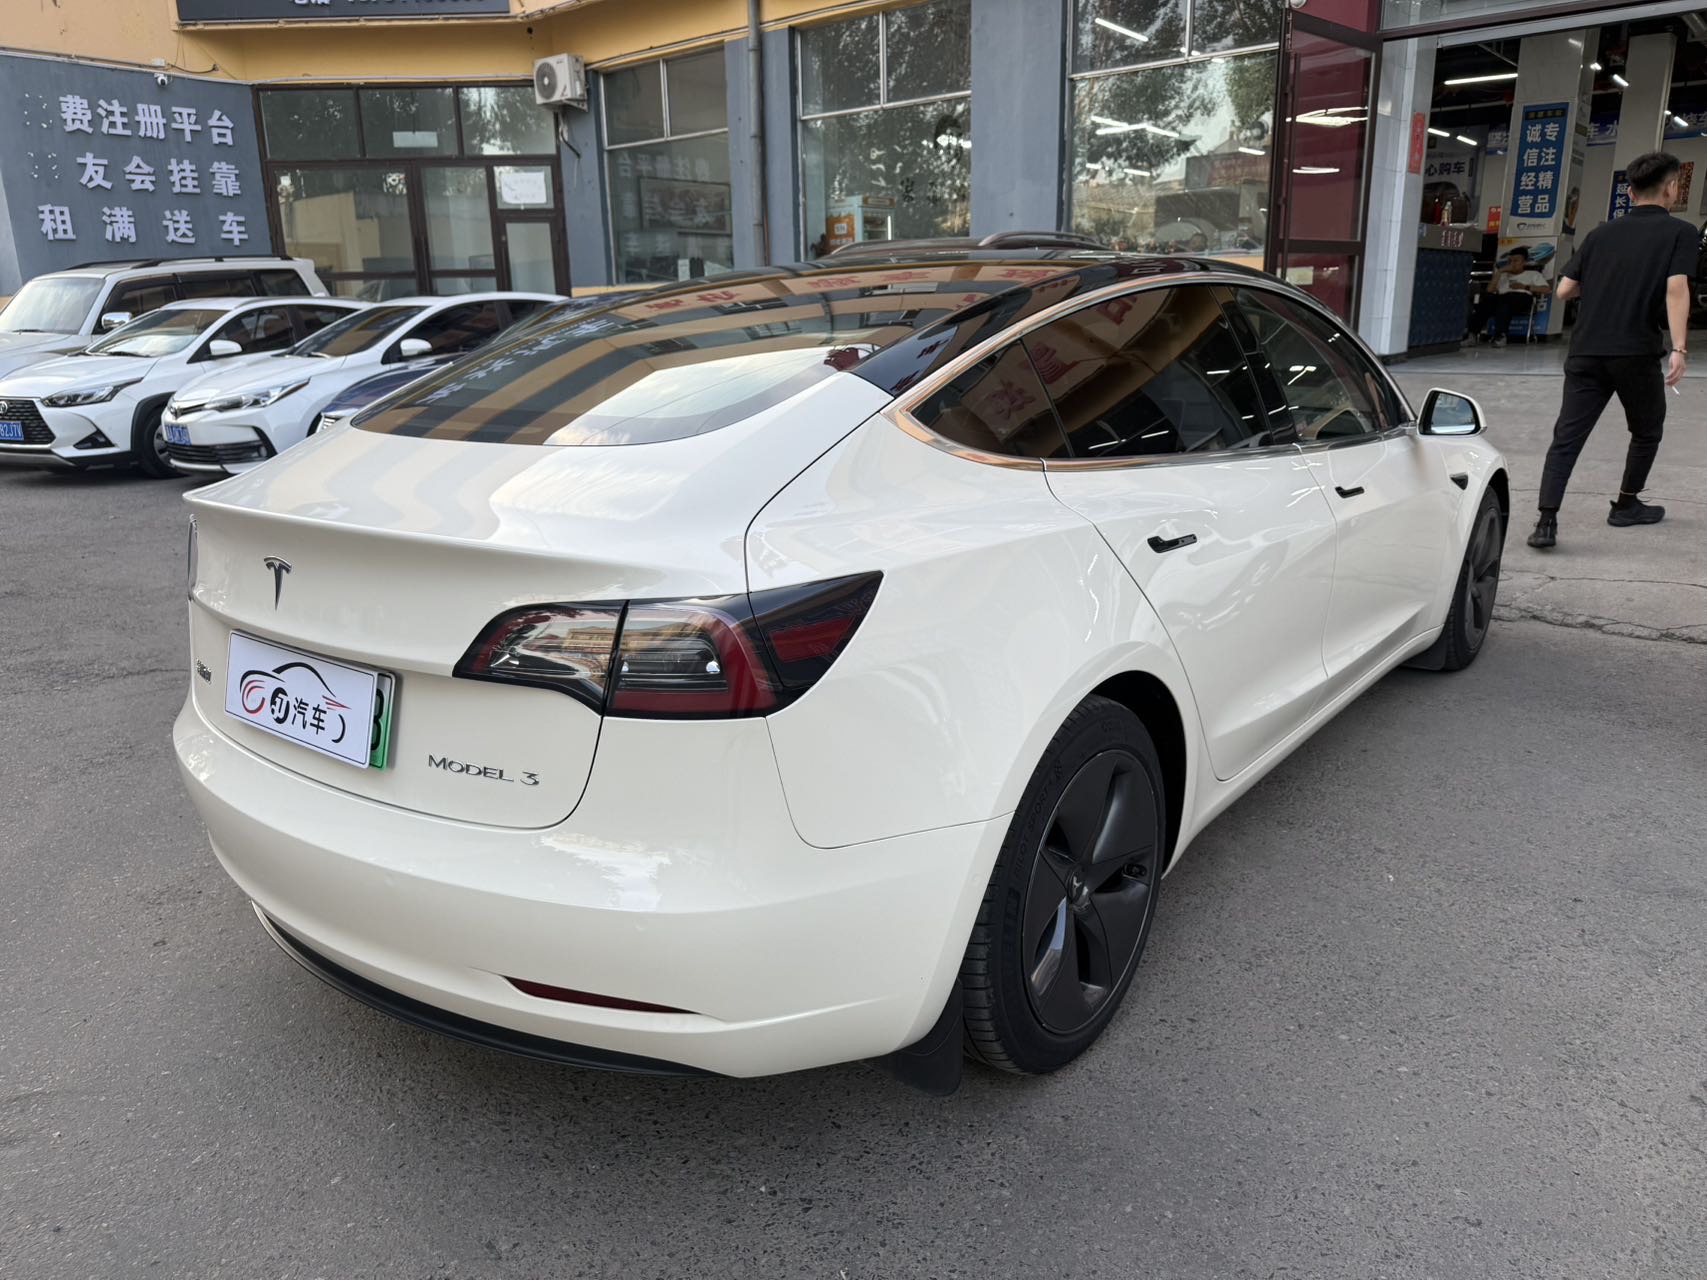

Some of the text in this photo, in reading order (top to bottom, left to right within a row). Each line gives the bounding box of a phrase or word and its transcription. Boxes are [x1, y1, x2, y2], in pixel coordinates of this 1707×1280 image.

[59, 94, 234, 146] 费注册平台
[76, 152, 241, 197] 友会挂靠
[1517, 124, 1542, 214] 诚信经营
[1534, 122, 1560, 213] 专注精品
[37, 203, 249, 246] 租满送车
[428, 754, 540, 786] MODEL 3
